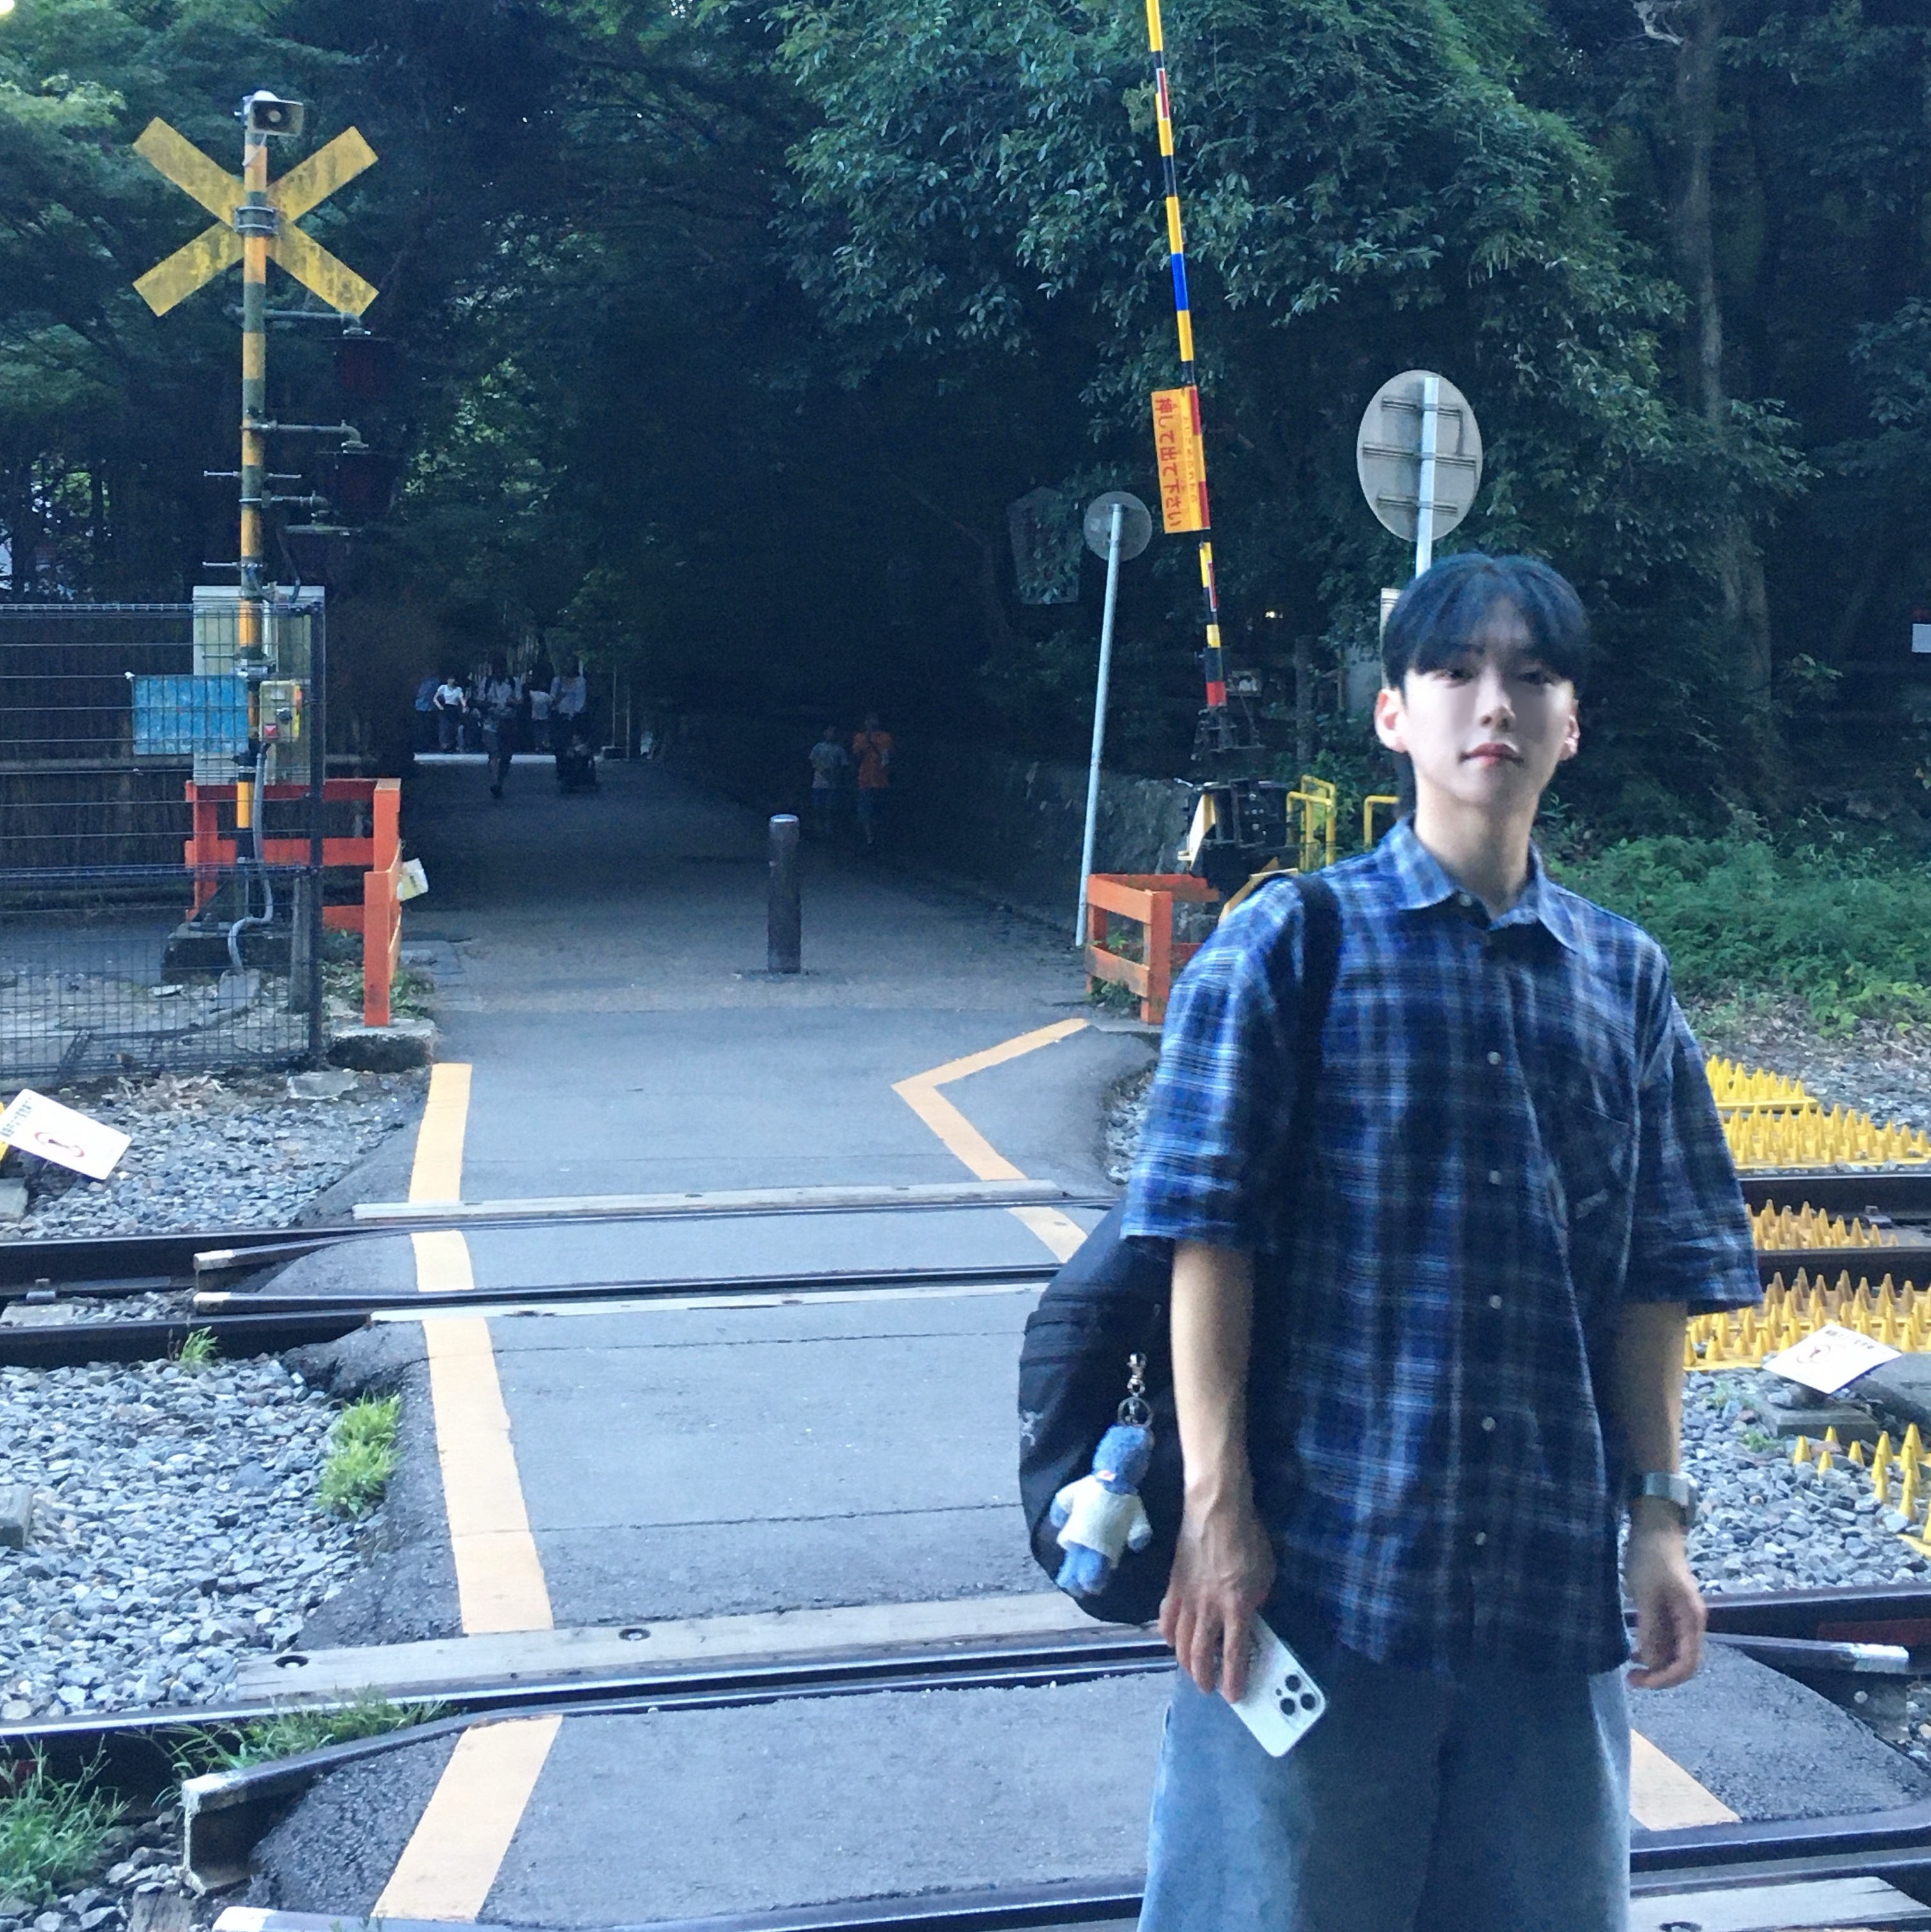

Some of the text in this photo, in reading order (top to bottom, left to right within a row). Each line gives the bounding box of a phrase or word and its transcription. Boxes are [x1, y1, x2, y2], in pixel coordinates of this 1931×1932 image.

[1154, 398, 1182, 526] 押して出て下さい
